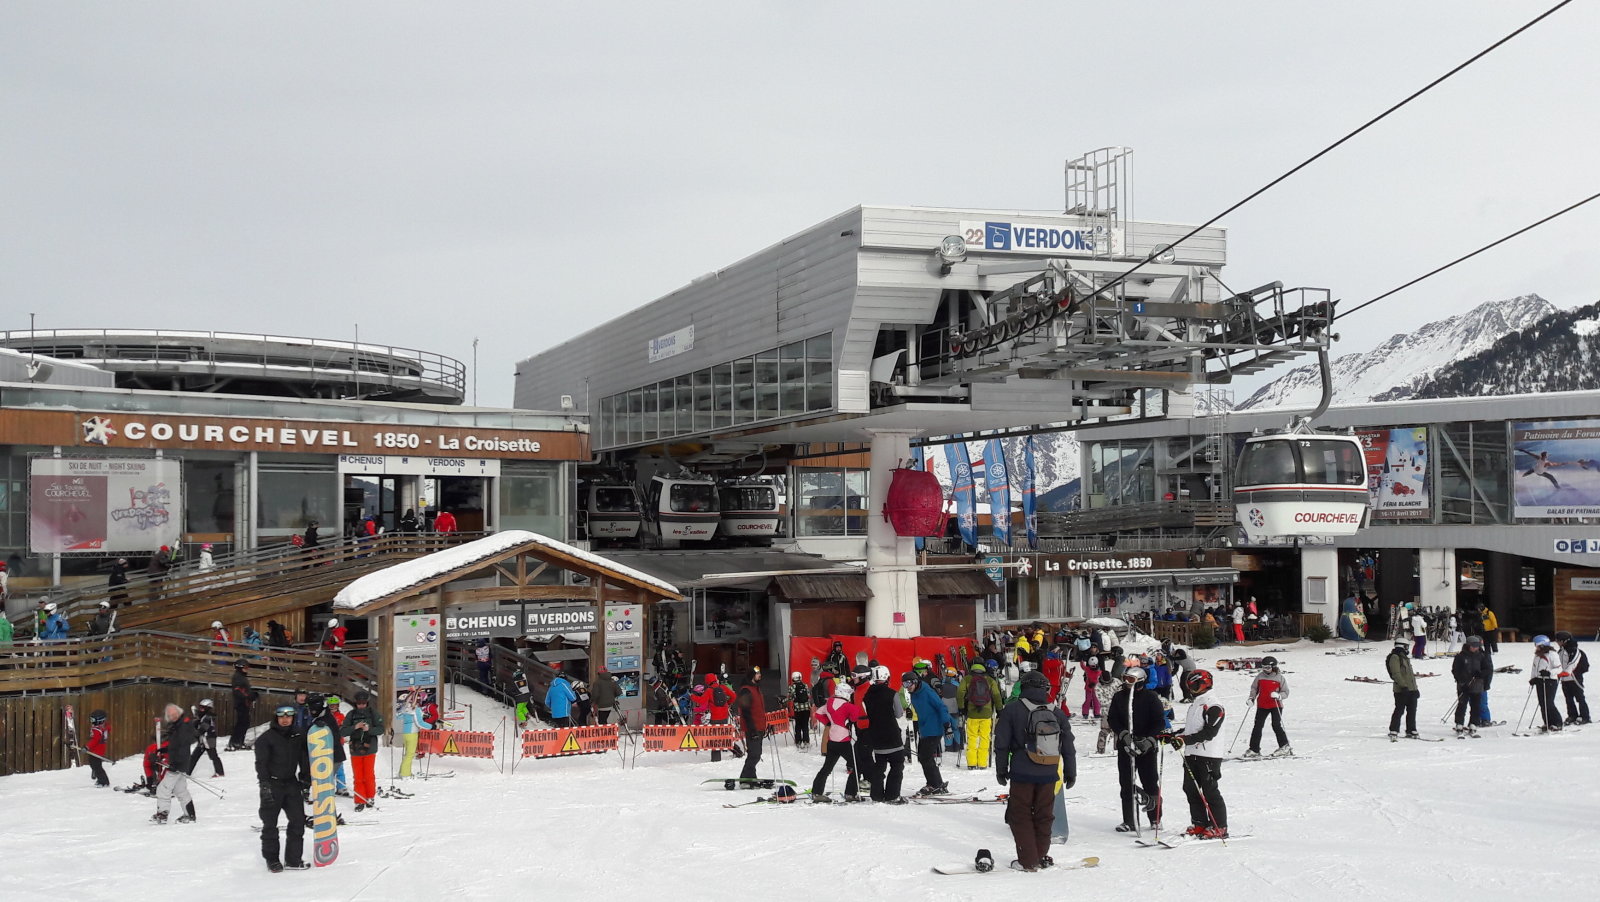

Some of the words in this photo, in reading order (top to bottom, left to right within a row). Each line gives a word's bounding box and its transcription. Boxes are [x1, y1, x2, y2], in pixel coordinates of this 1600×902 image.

[966, 228, 984, 246] 22
[1013, 227, 1097, 251] VERDONS
[1136, 303, 1141, 312] 1
[124, 422, 358, 447] COURCHEVEL
[373, 432, 420, 449] 1850
[439, 435, 460, 450] La
[465, 435, 541, 453] Croisette
[348, 456, 383, 465] CHENUS
[428, 458, 465, 468] VERDONS
[1294, 512, 1358, 524] COURCHEVEL
[1045, 560, 1060, 571] La
[458, 615, 517, 630] CHENUS
[539, 611, 595, 625] VERDONS
[420, 731, 440, 740] LENTIR
[455, 733, 492, 744] RALLENTARE
[525, 732, 558, 743] RALENTIR
[575, 725, 617, 739] RALLENTARE
[645, 727, 677, 737] RALENTIR
[693, 727, 733, 736] RALLENTARE
[525, 745, 544, 755] SLOW
[584, 739, 616, 750] LANGSAM
[645, 739, 664, 749] SLOW
[701, 738, 732, 748] LANGSAM
[307, 728, 339, 865] CUSTOM
